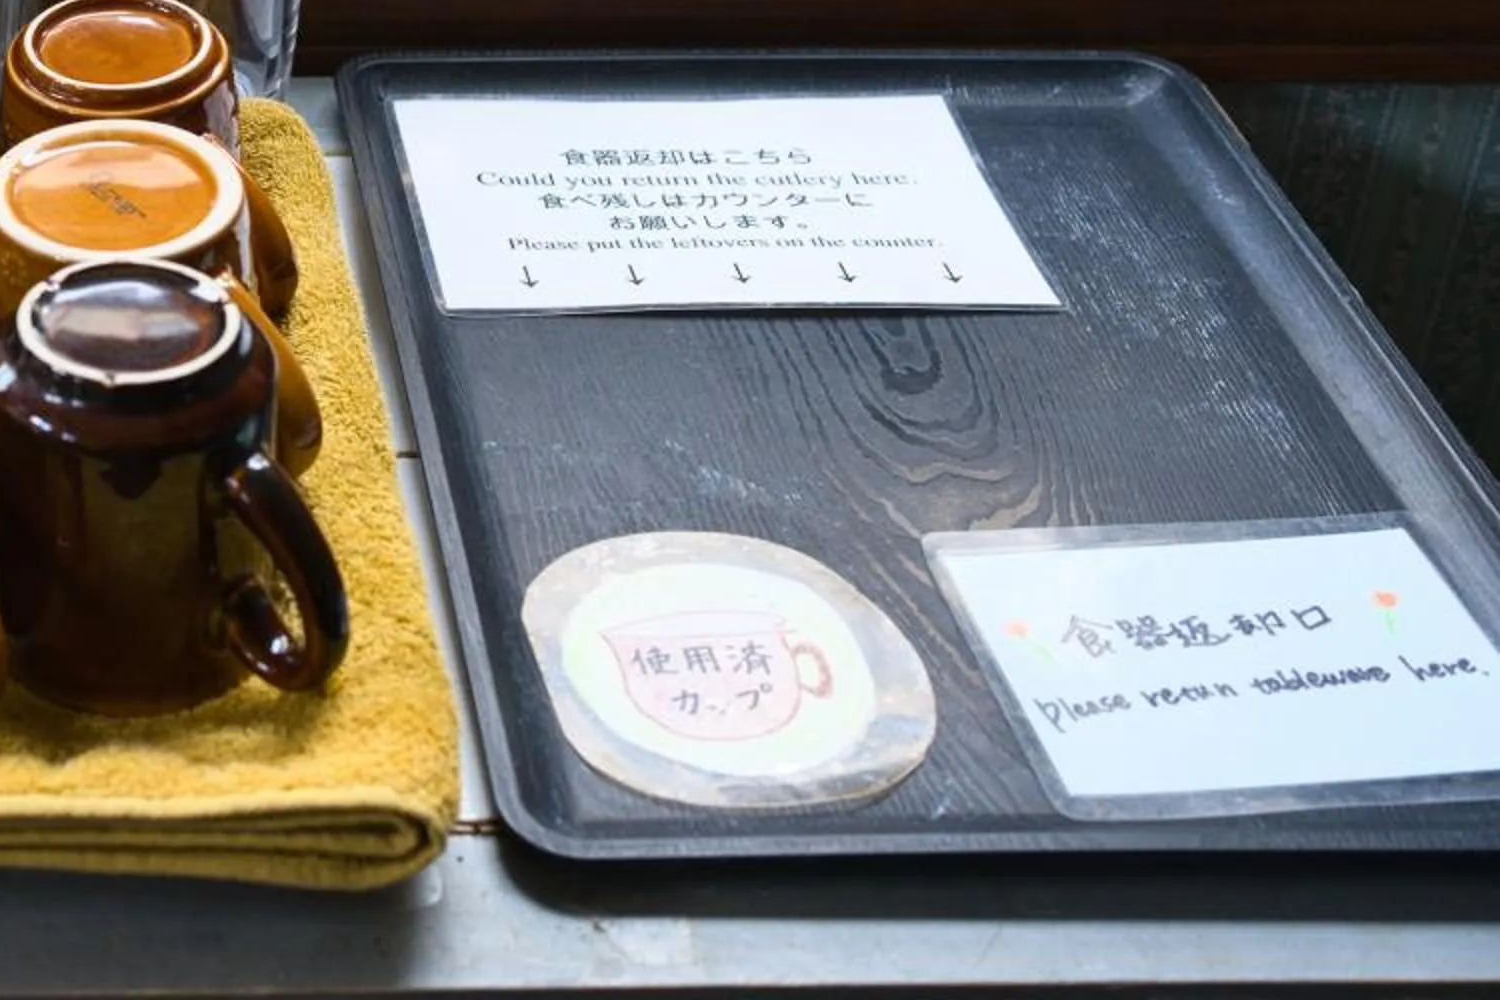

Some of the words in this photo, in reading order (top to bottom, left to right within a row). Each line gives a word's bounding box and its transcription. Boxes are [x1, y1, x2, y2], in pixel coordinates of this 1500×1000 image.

[560, 148, 812, 166] 食器返却はこちら
[476, 171, 556, 187] Could
[565, 175, 612, 191] you
[621, 174, 698, 186] return
[706, 172, 746, 186] the
[754, 173, 842, 189] cutlery
[538, 193, 874, 209] 食べ残しはカウンターに
[609, 215, 808, 231] お願いします。
[507, 238, 581, 251] Please
[587, 238, 622, 254] put
[630, 237, 666, 250] the
[672, 236, 770, 249] leftovers
[775, 238, 805, 248] on
[812, 236, 846, 248] the
[631, 640, 774, 676] 使用済
[671, 683, 773, 715] カップ
